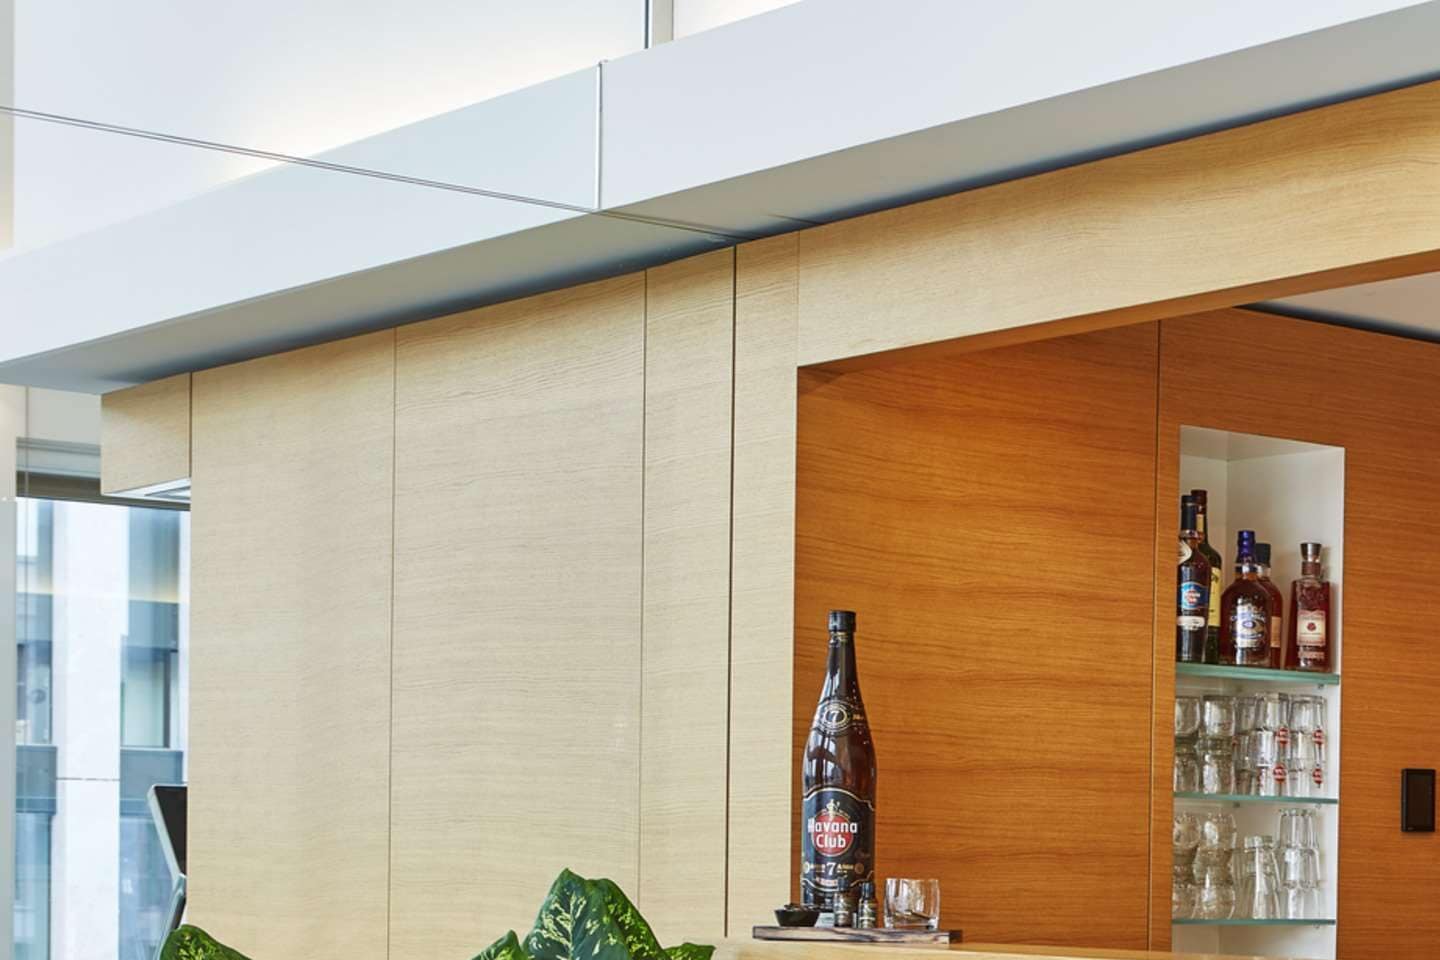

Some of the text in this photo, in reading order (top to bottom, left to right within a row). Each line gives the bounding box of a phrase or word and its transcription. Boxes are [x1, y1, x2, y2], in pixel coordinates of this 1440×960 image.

[830, 710, 840, 722] 7
[807, 818, 858, 833] Havana
[816, 834, 846, 848] Club
[826, 862, 836, 876] 7
